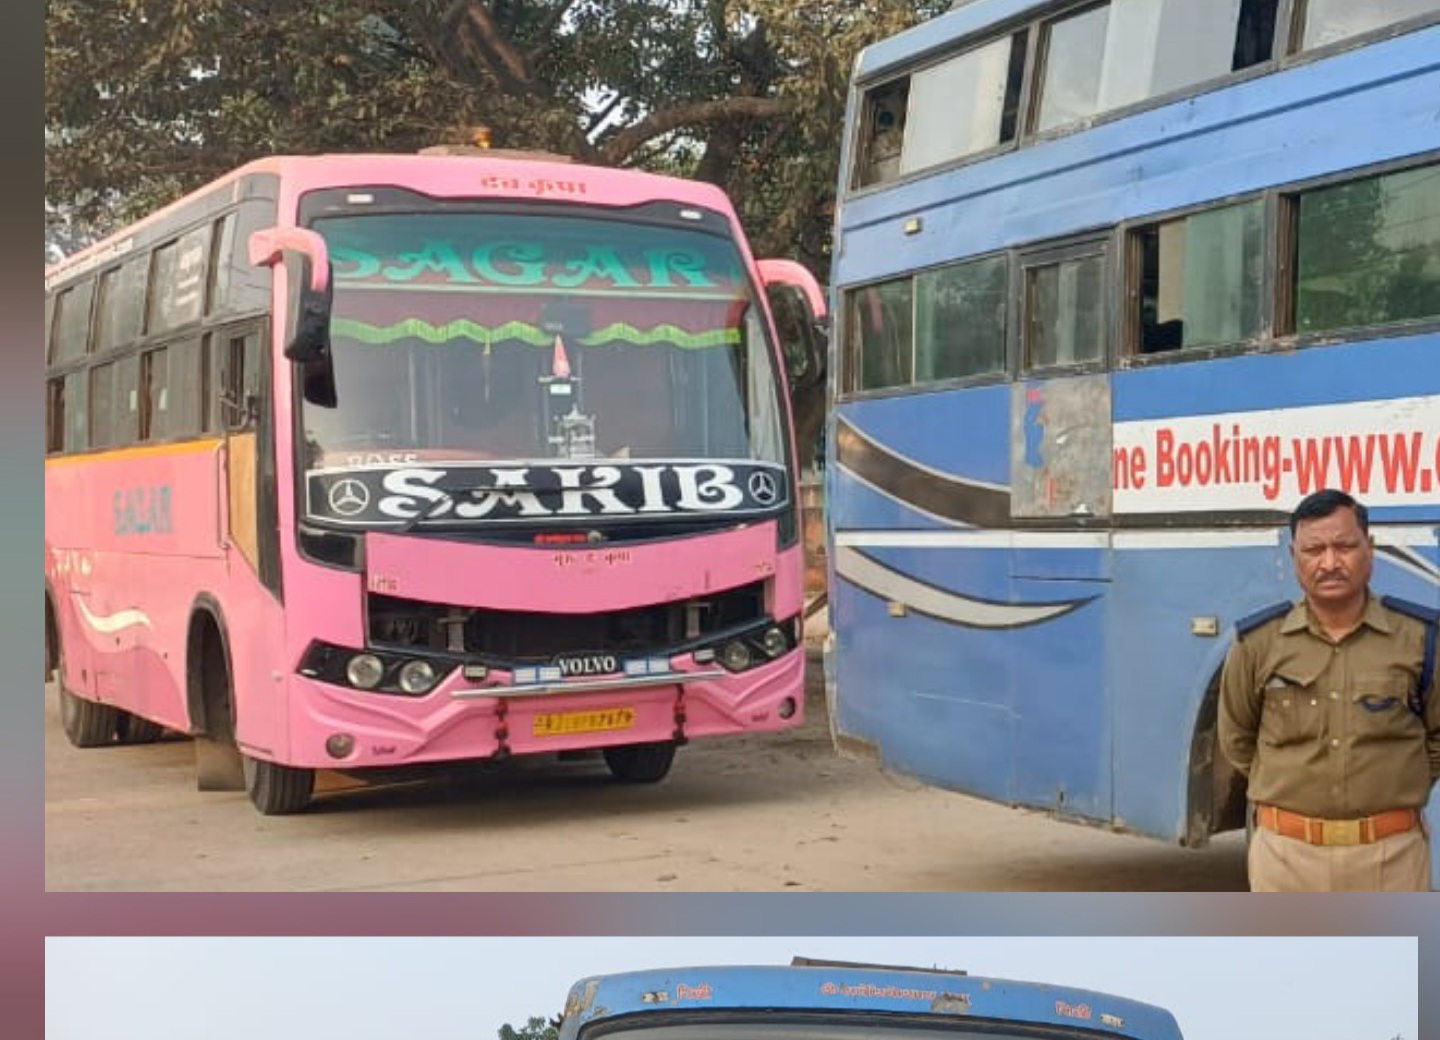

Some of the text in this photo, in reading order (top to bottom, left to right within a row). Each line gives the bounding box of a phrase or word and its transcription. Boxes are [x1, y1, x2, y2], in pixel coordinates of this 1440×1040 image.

[331, 239, 720, 287] SAGAR
[377, 464, 744, 519] SAKIB
[558, 656, 616, 674] VOLVO
